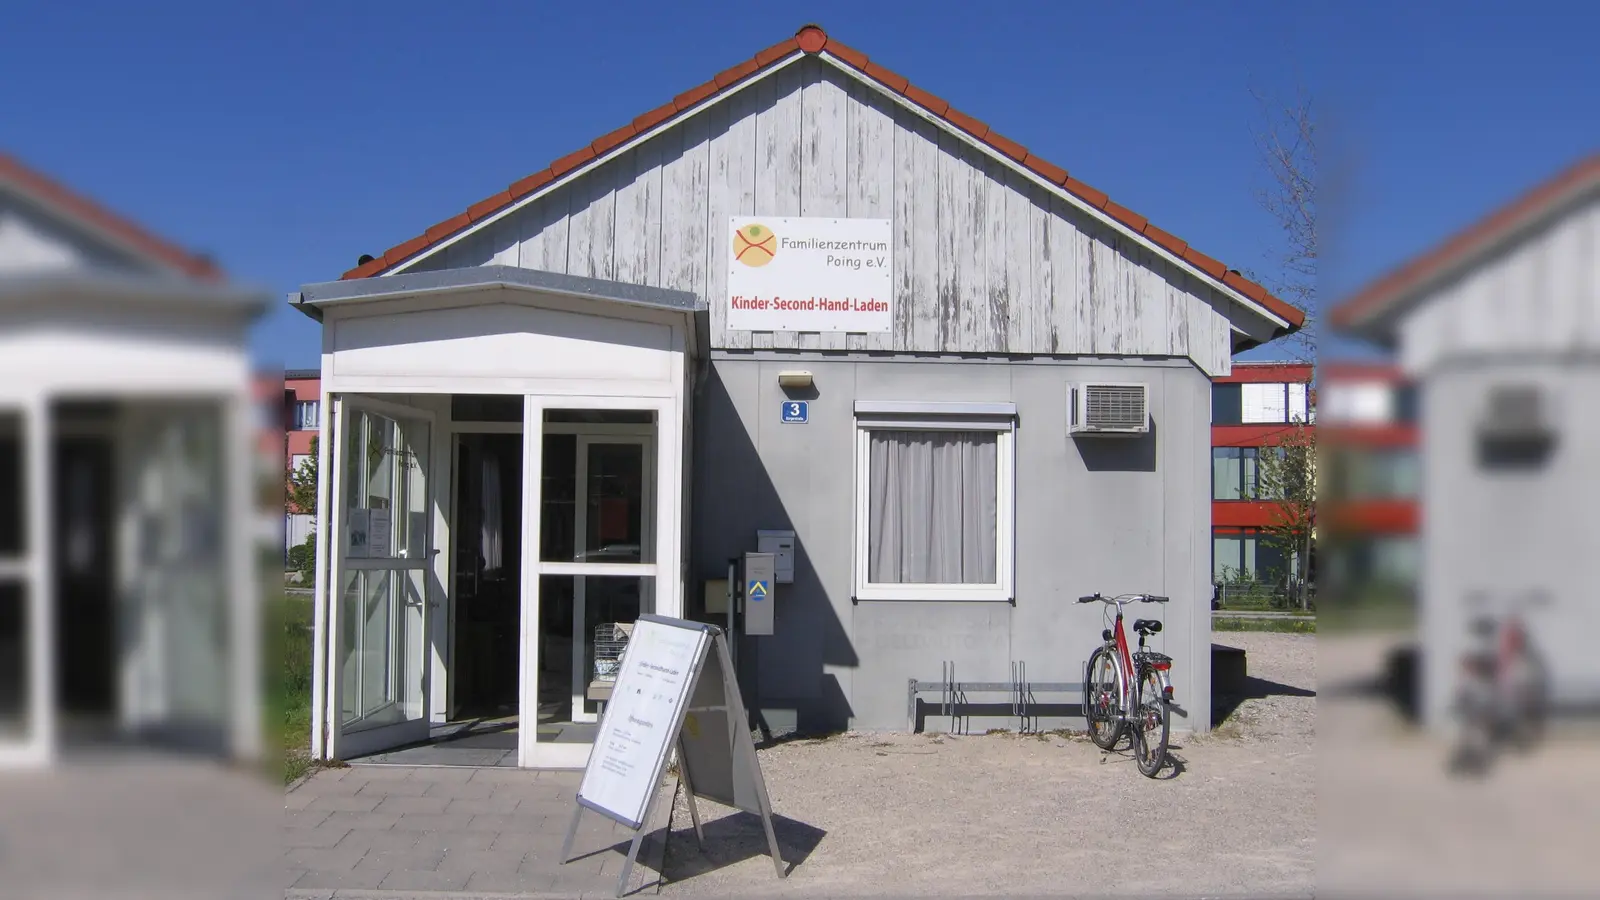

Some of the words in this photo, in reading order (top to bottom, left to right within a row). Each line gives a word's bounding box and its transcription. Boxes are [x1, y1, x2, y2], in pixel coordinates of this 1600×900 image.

[781, 237, 887, 251] Familienzentrum
[826, 255, 861, 270] Poing
[866, 256, 887, 268] e.V.
[731, 295, 889, 312] Kinder-Second-Hand-Laden
[790, 403, 800, 416] 3
